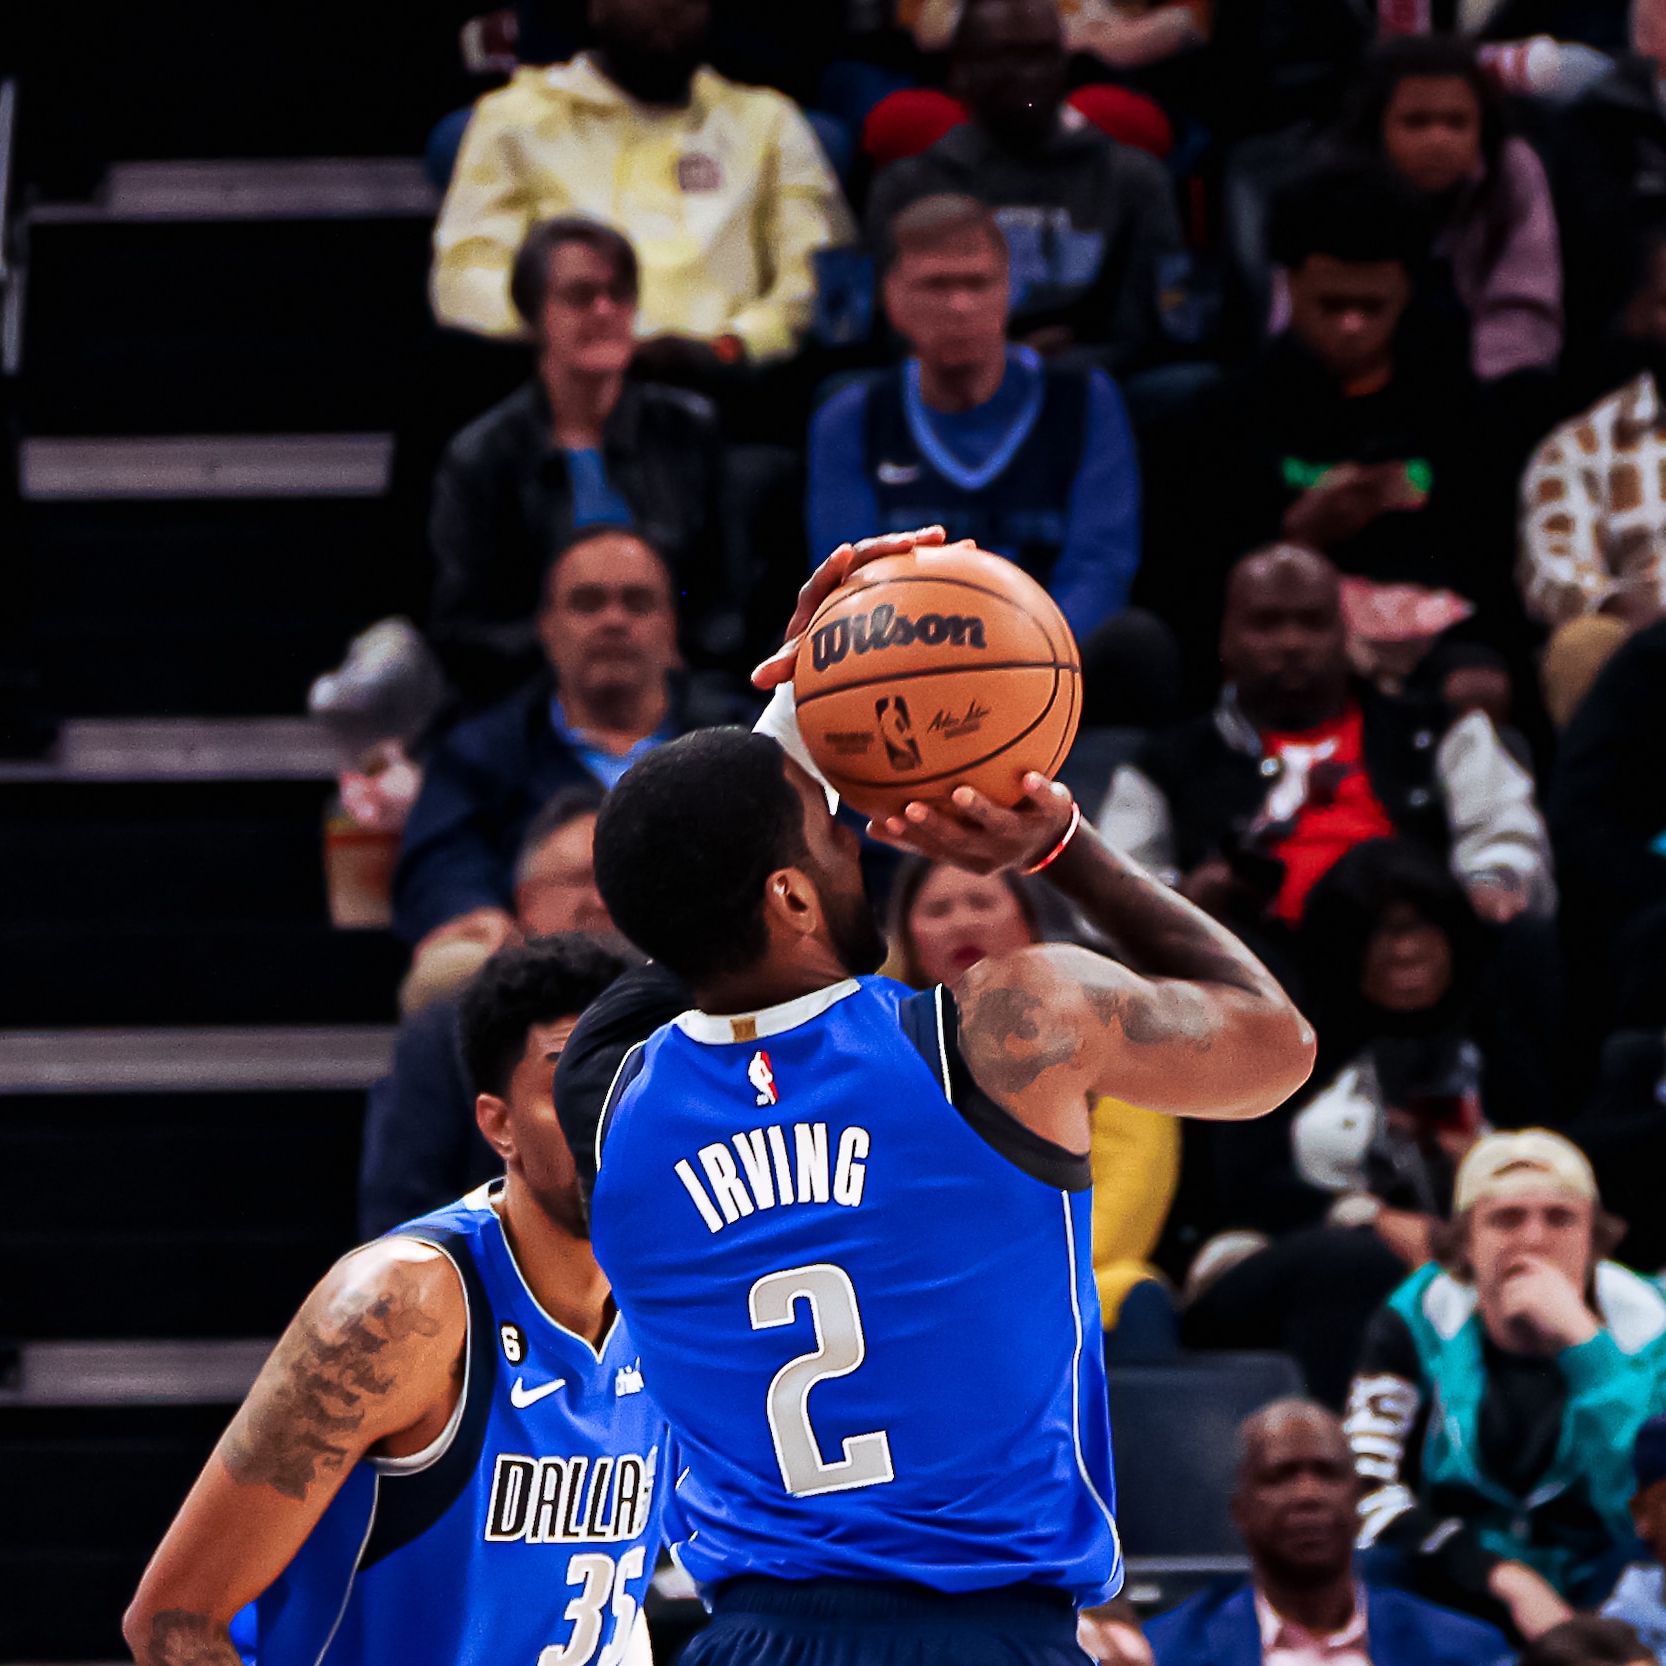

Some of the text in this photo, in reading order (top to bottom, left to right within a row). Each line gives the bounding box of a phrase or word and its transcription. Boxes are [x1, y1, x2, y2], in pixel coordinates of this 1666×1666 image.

[811, 603, 987, 673] Wilson
[674, 1123, 870, 1233] IRVING
[501, 1325, 520, 1362] 6
[749, 1263, 894, 1497] 2
